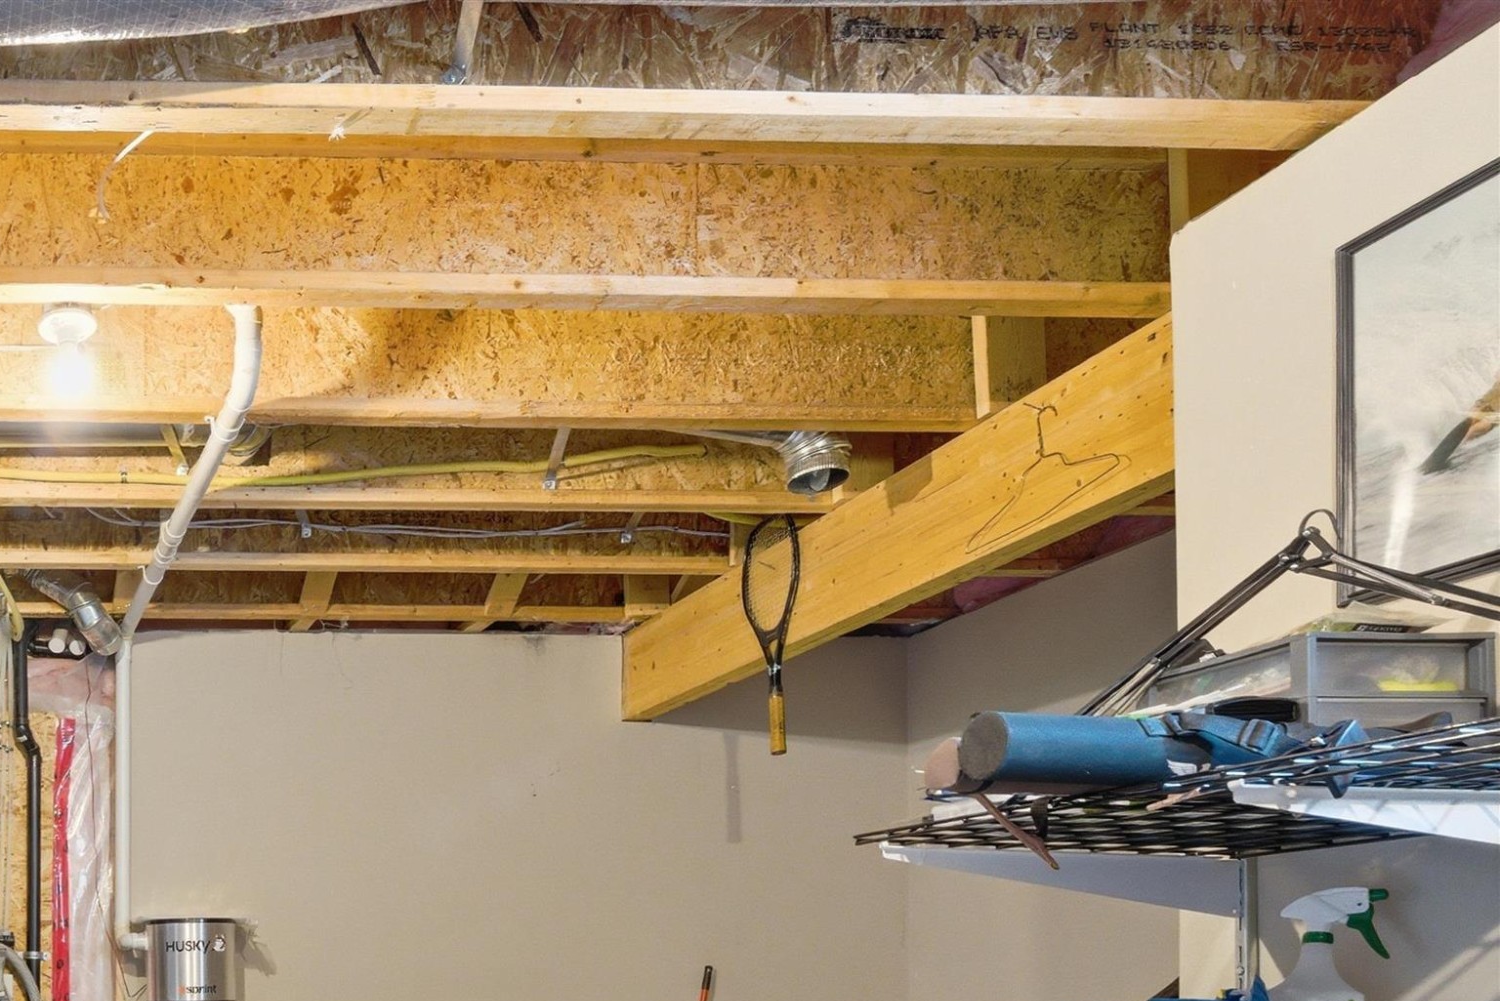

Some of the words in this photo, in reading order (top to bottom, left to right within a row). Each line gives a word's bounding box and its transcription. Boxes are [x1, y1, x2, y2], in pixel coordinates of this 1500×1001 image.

[1089, 22, 1159, 34] PLANT
[165, 940, 211, 954] HUSKY
[186, 984, 217, 994] sprint
